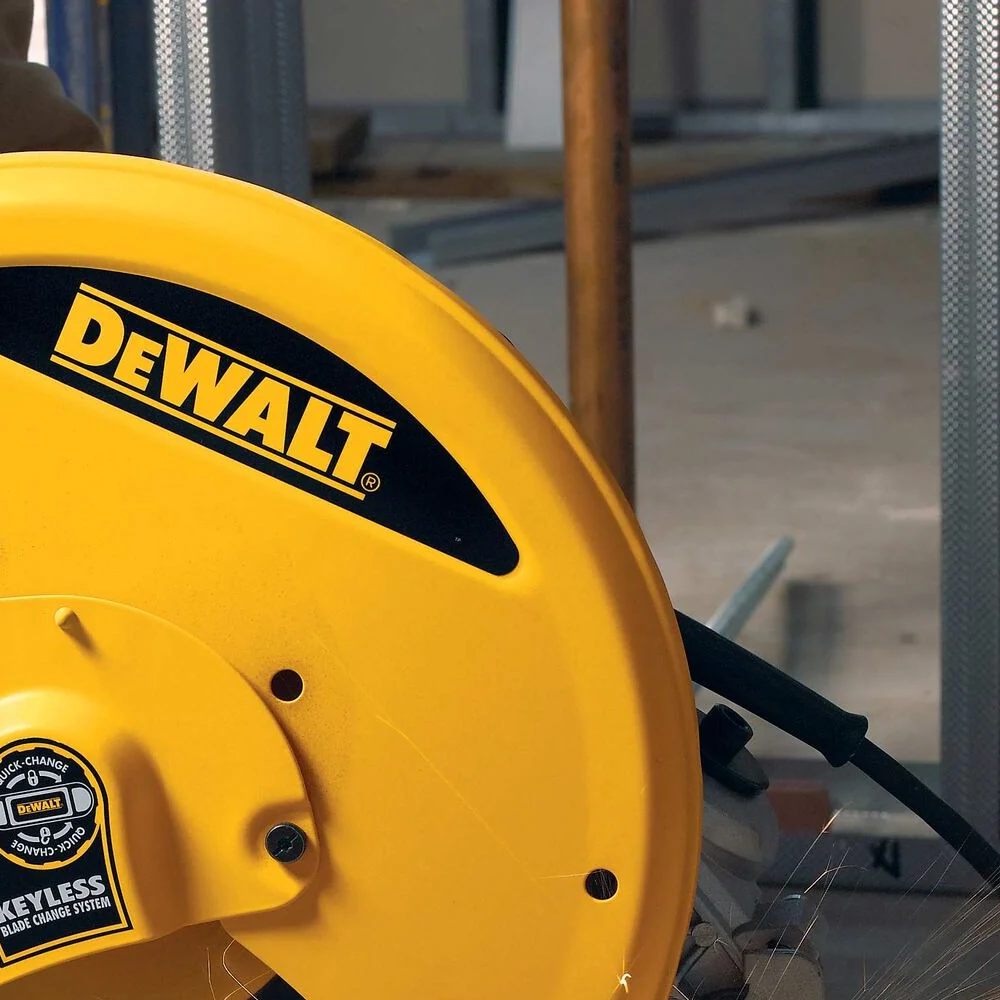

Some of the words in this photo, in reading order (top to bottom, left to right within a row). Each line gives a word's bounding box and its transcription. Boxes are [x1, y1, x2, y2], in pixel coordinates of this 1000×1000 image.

[53, 291, 394, 486] DEWALT
[11, 827, 86, 857] QUICK-CHANGE
[0, 920, 31, 938] BLADE
[32, 907, 72, 926] CHANGE
[74, 896, 111, 915] SYSTEM
